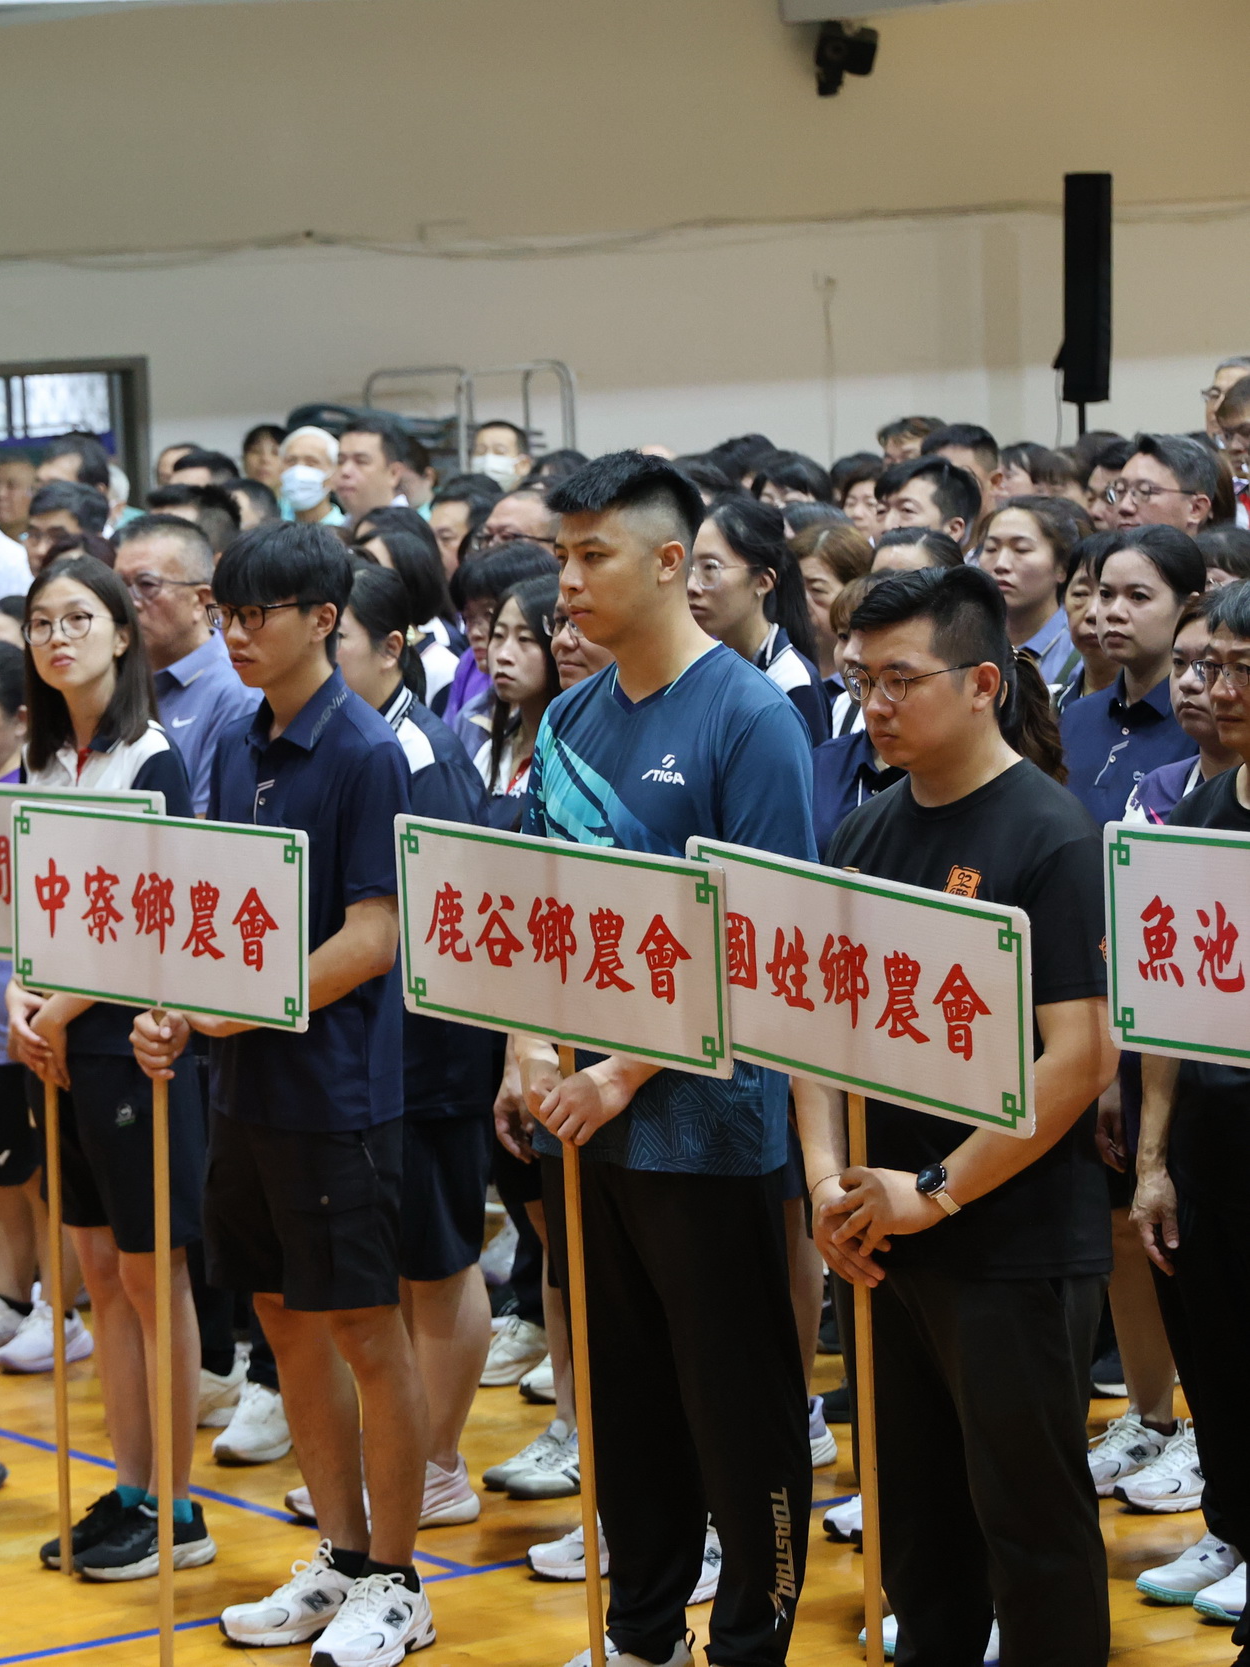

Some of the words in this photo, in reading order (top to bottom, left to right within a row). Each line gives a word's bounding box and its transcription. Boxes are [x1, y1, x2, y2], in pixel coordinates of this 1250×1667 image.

[641, 769, 685, 786] STIGA
[34, 857, 279, 972] 中寮鄉農會
[951, 872, 972, 889] 92
[424, 882, 692, 1004] 鹿谷鄉農會
[727, 912, 992, 1061] 國姓鄉農會
[1138, 895, 1245, 993] 魚池
